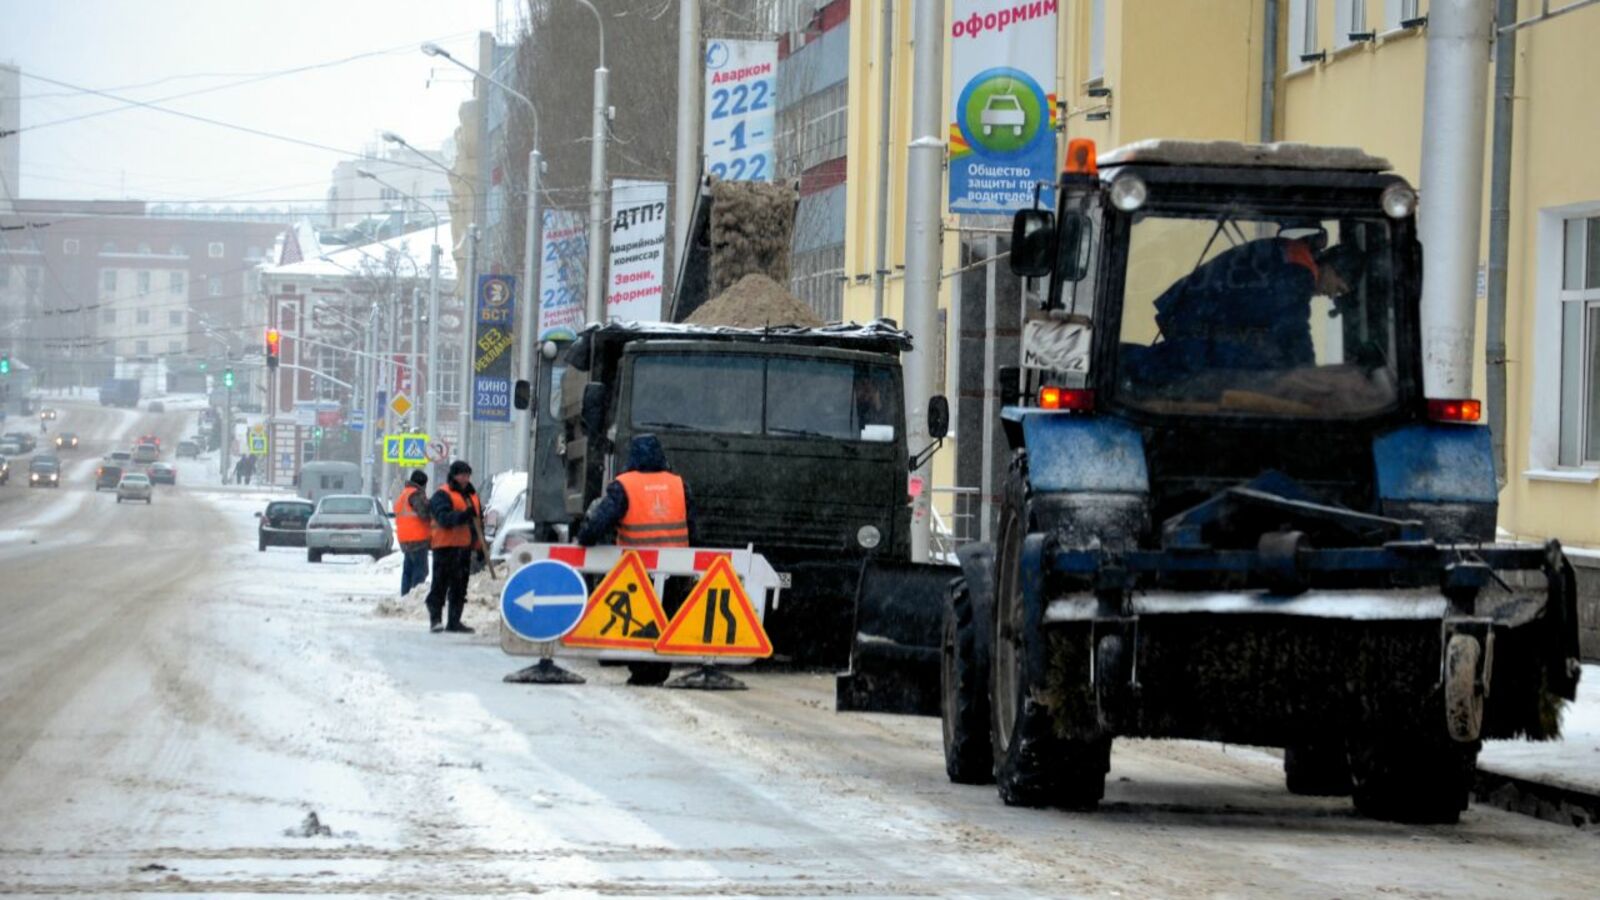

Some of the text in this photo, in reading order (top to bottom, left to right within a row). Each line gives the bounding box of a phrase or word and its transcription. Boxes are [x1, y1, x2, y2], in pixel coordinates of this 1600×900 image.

[952, 0, 1057, 38] оформим
[711, 62, 771, 85] Аварком
[711, 80, 776, 120] 222-
[712, 120, 764, 151] -1-
[968, 164, 1031, 179] Общество
[968, 178, 1016, 190] защиты
[968, 188, 1035, 202] водителей
[613, 202, 665, 232] ДТП?
[609, 235, 665, 254] Аварийный
[613, 249, 660, 266] комиссар
[614, 269, 655, 286] Звони,
[607, 284, 662, 305] оформим
[481, 308, 510, 321] БСТ
[478, 328, 502, 352] БЕЗ
[477, 379, 508, 393] КИНО
[477, 393, 508, 408] 23.00
